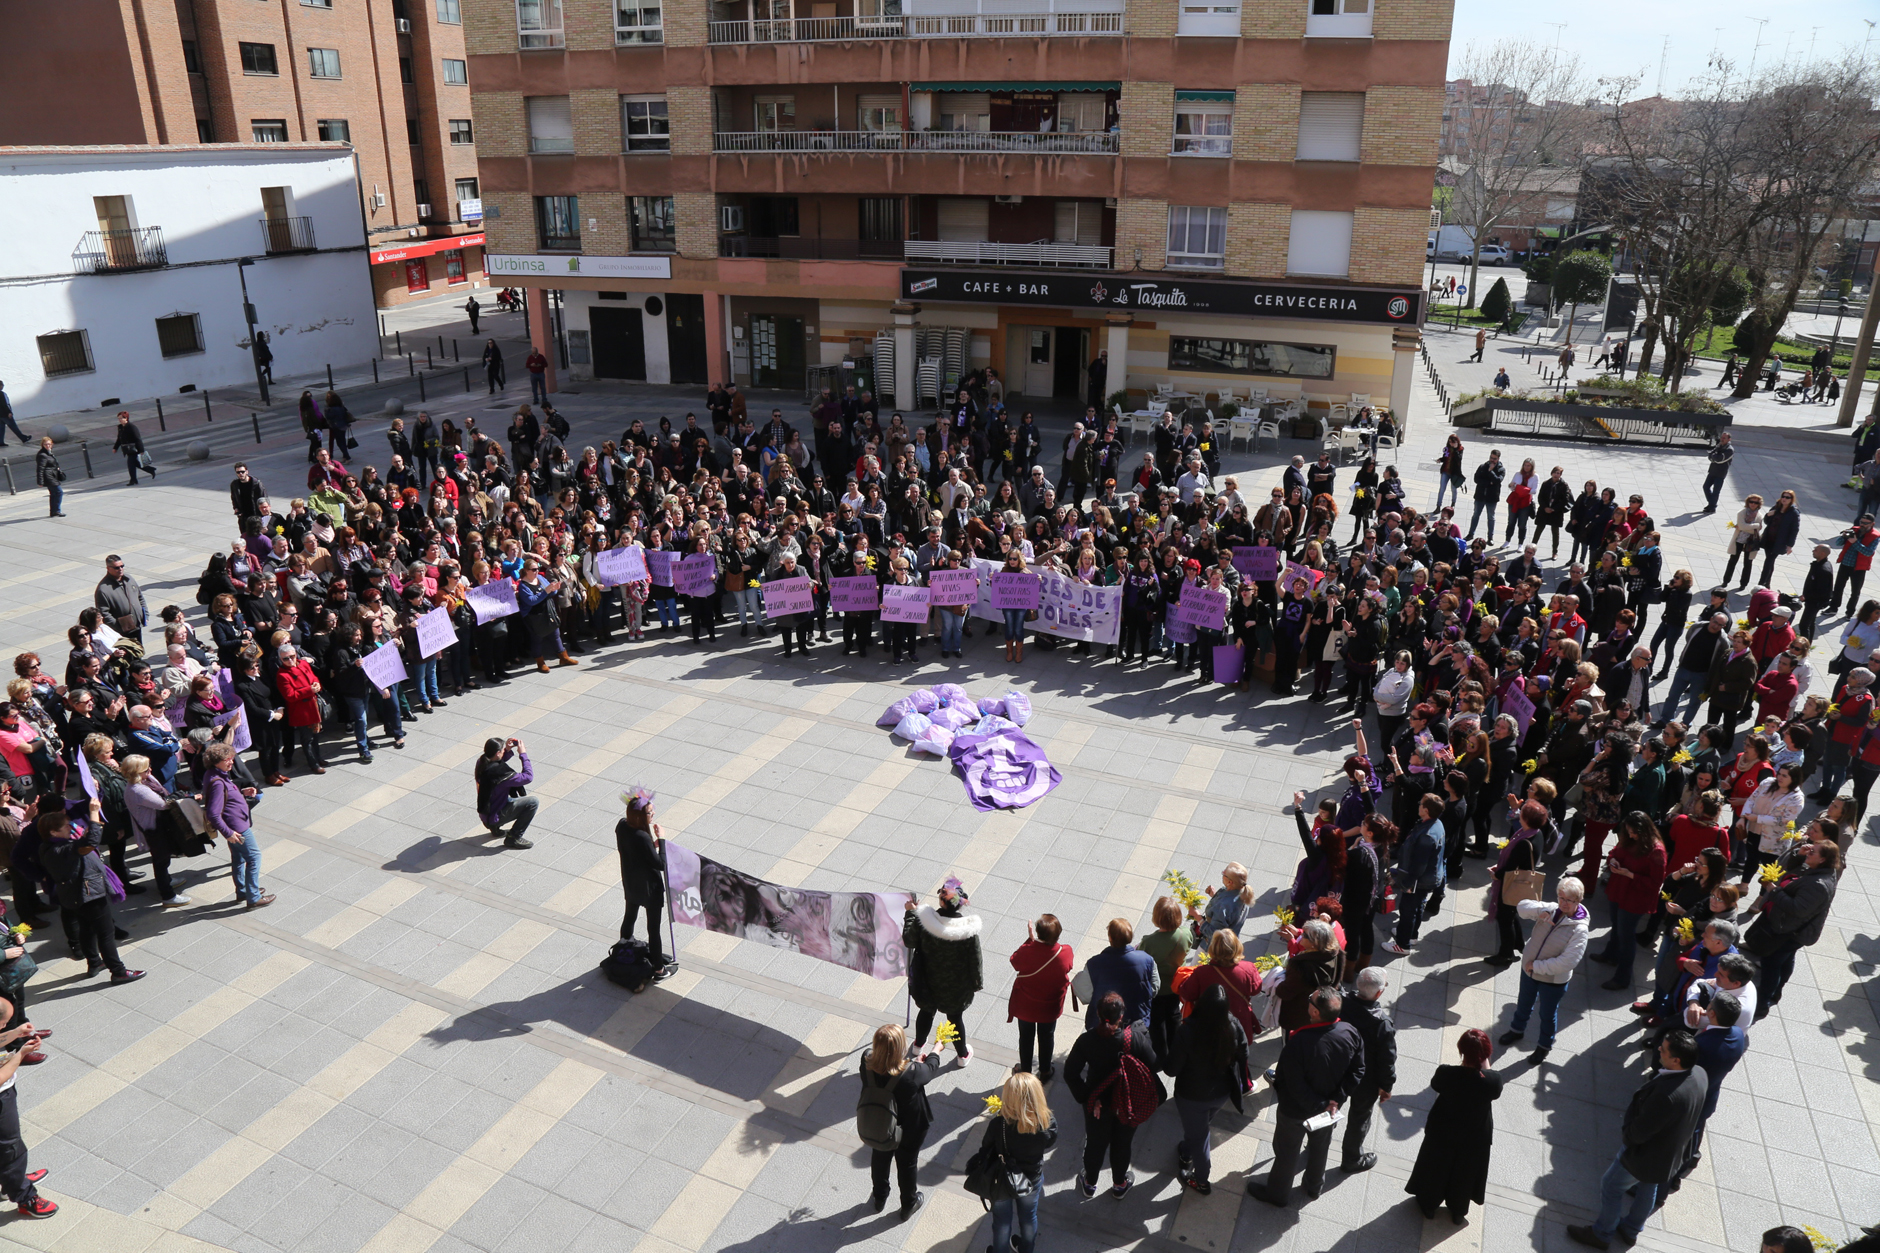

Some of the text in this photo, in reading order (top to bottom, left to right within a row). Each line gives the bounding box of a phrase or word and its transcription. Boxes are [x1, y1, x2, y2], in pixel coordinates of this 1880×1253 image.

[465, 237, 484, 245] Santander
[384, 251, 407, 261] Santander
[494, 257, 545, 271] Urbinsa
[963, 281, 1049, 295] CAFE BAR
[1112, 288, 1129, 304] La
[1130, 283, 1188, 308] Tasquita
[1254, 294, 1357, 311] CERVECERIA
[606, 559, 640, 573] MOSTOLES
[1243, 559, 1264, 568] VIVAS
[606, 569, 640, 583] PARAMOS
[684, 571, 702, 581] VIVAS
[957, 571, 975, 581] MENOS
[1015, 576, 1037, 585] MARZO
[941, 584, 961, 592] VIVAS
[998, 586, 1031, 596] NOSOTRAS
[851, 595, 876, 605] SALARIO
[933, 593, 976, 603] NOS QUEREMOS
[999, 597, 1031, 606] PARAMOS
[1082, 589, 1106, 609] DE
[1202, 592, 1224, 604] MARZO
[789, 600, 812, 611] SALARIO
[903, 610, 927, 620] SALARIO
[424, 633, 451, 654] PARAMOS
